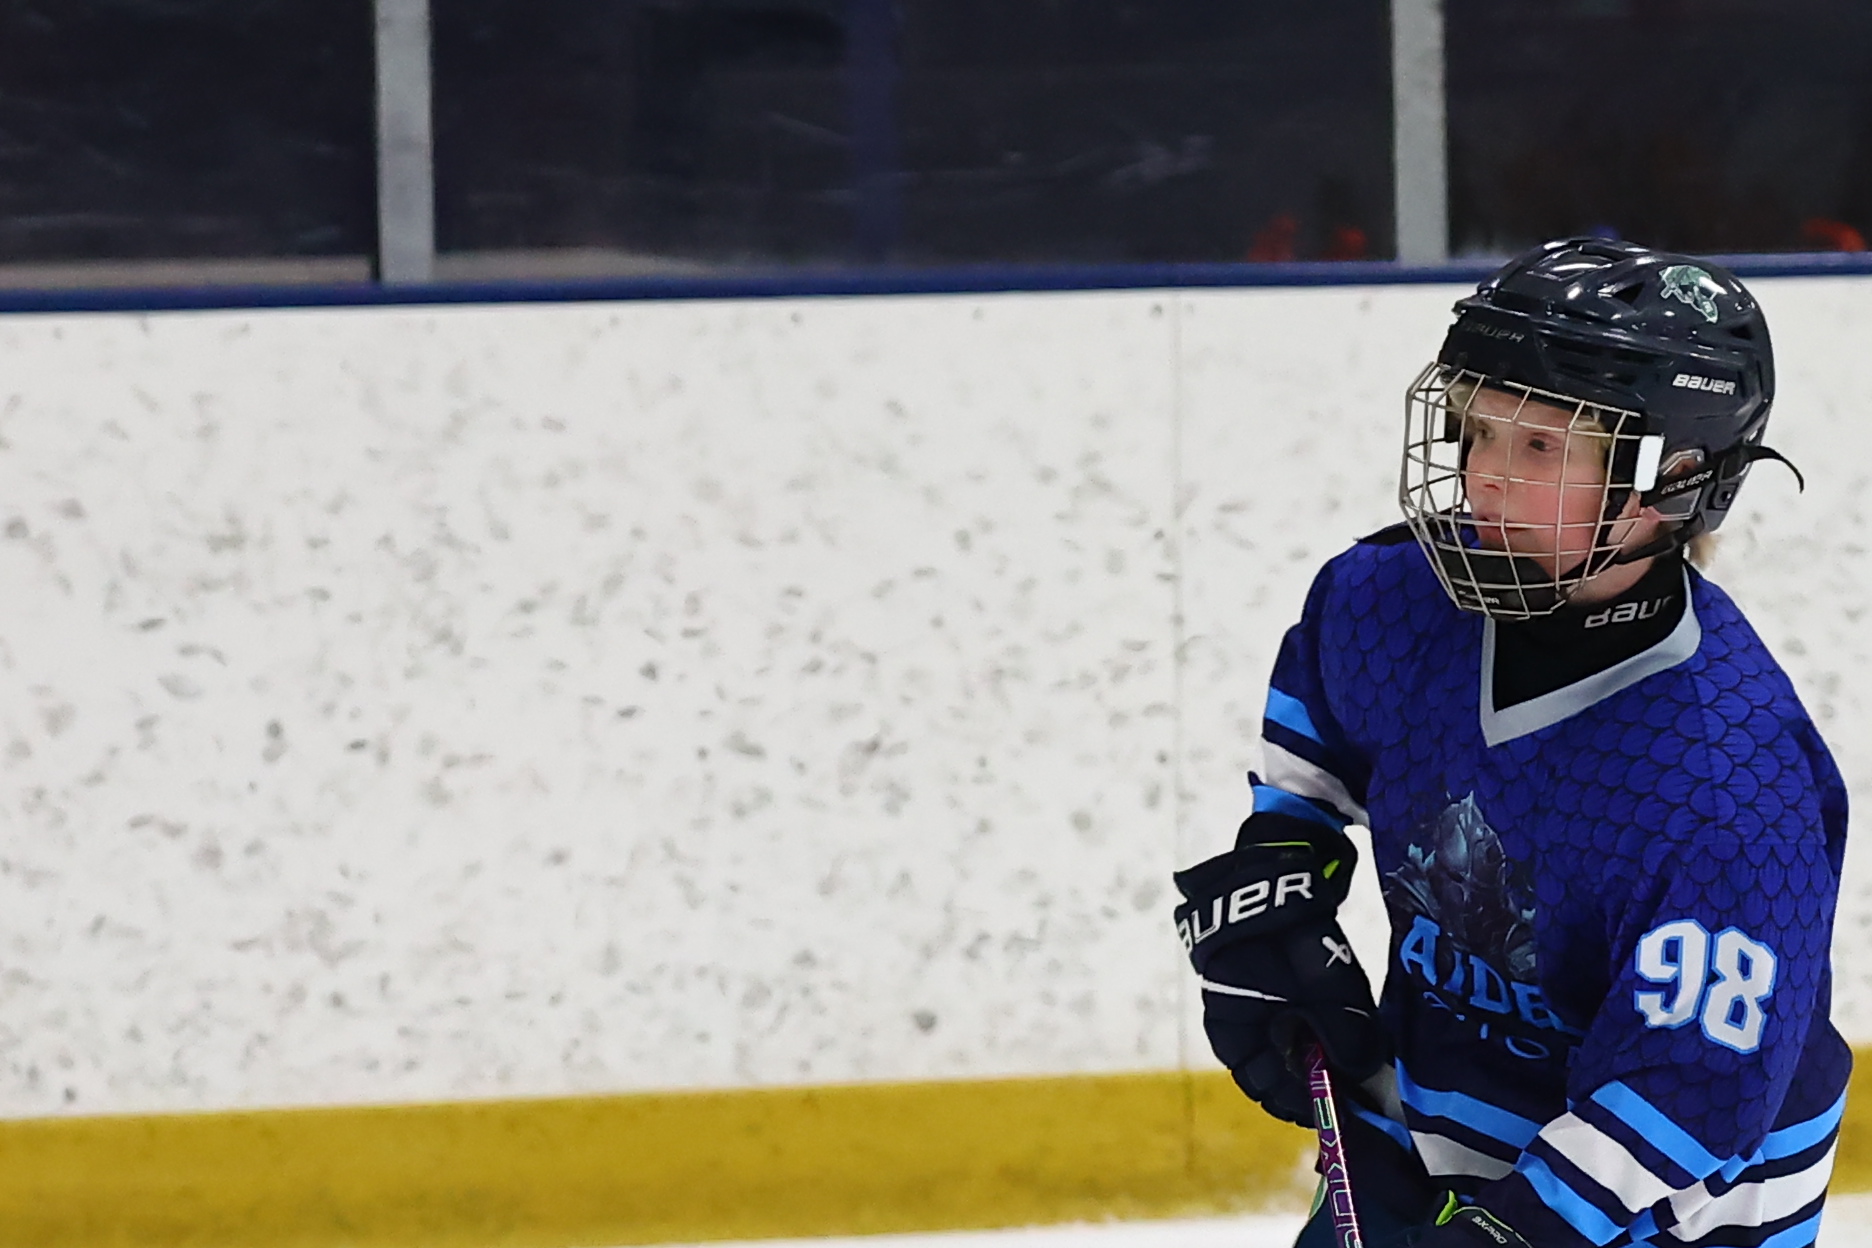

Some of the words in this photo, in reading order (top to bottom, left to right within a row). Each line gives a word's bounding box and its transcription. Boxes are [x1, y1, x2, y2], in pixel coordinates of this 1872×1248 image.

[1672, 373, 1736, 396] BAUER
[1584, 595, 1674, 629] BAU
[1178, 871, 1314, 952] AUER
[1634, 919, 1778, 1055] 98
